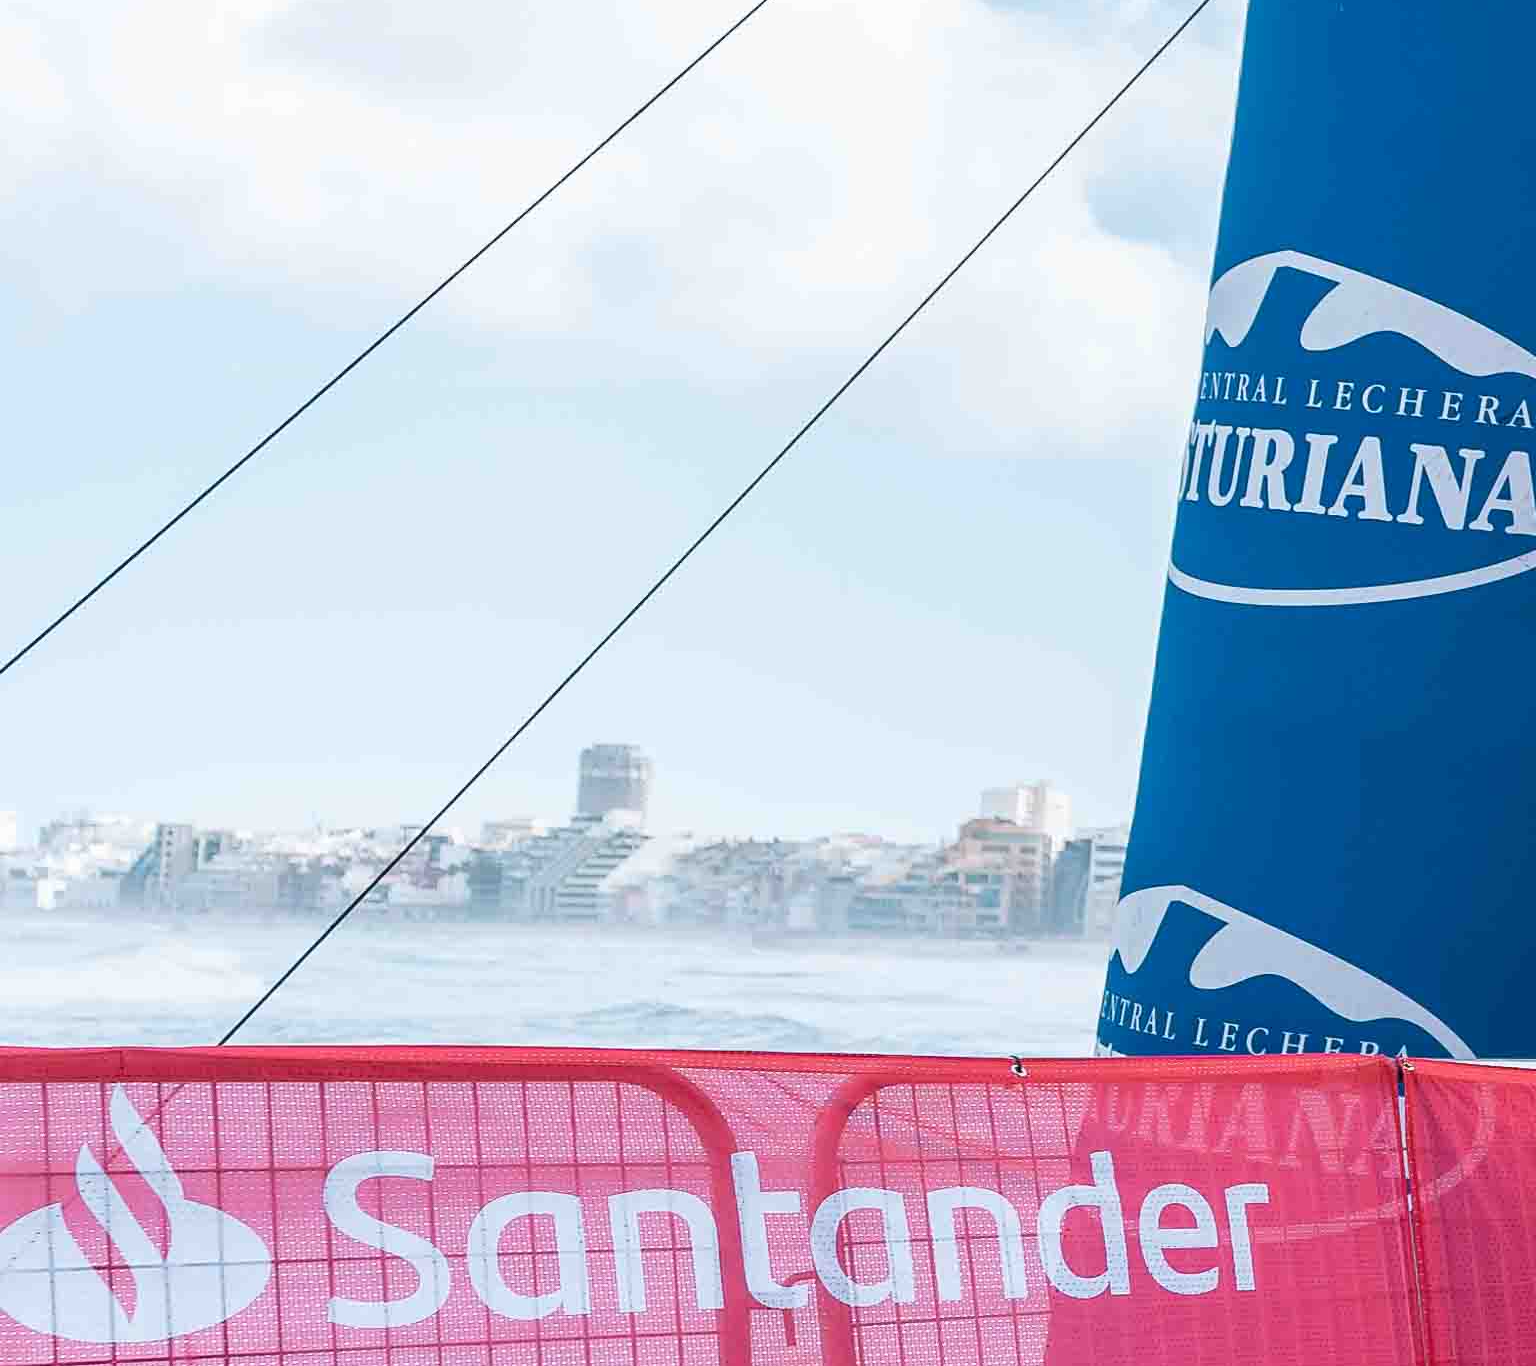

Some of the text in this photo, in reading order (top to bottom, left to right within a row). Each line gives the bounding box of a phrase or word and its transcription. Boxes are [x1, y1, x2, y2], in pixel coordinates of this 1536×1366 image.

[1199, 371, 1535, 429] ENTRAL LECHERA
[322, 1149, 1270, 1329] Santander
